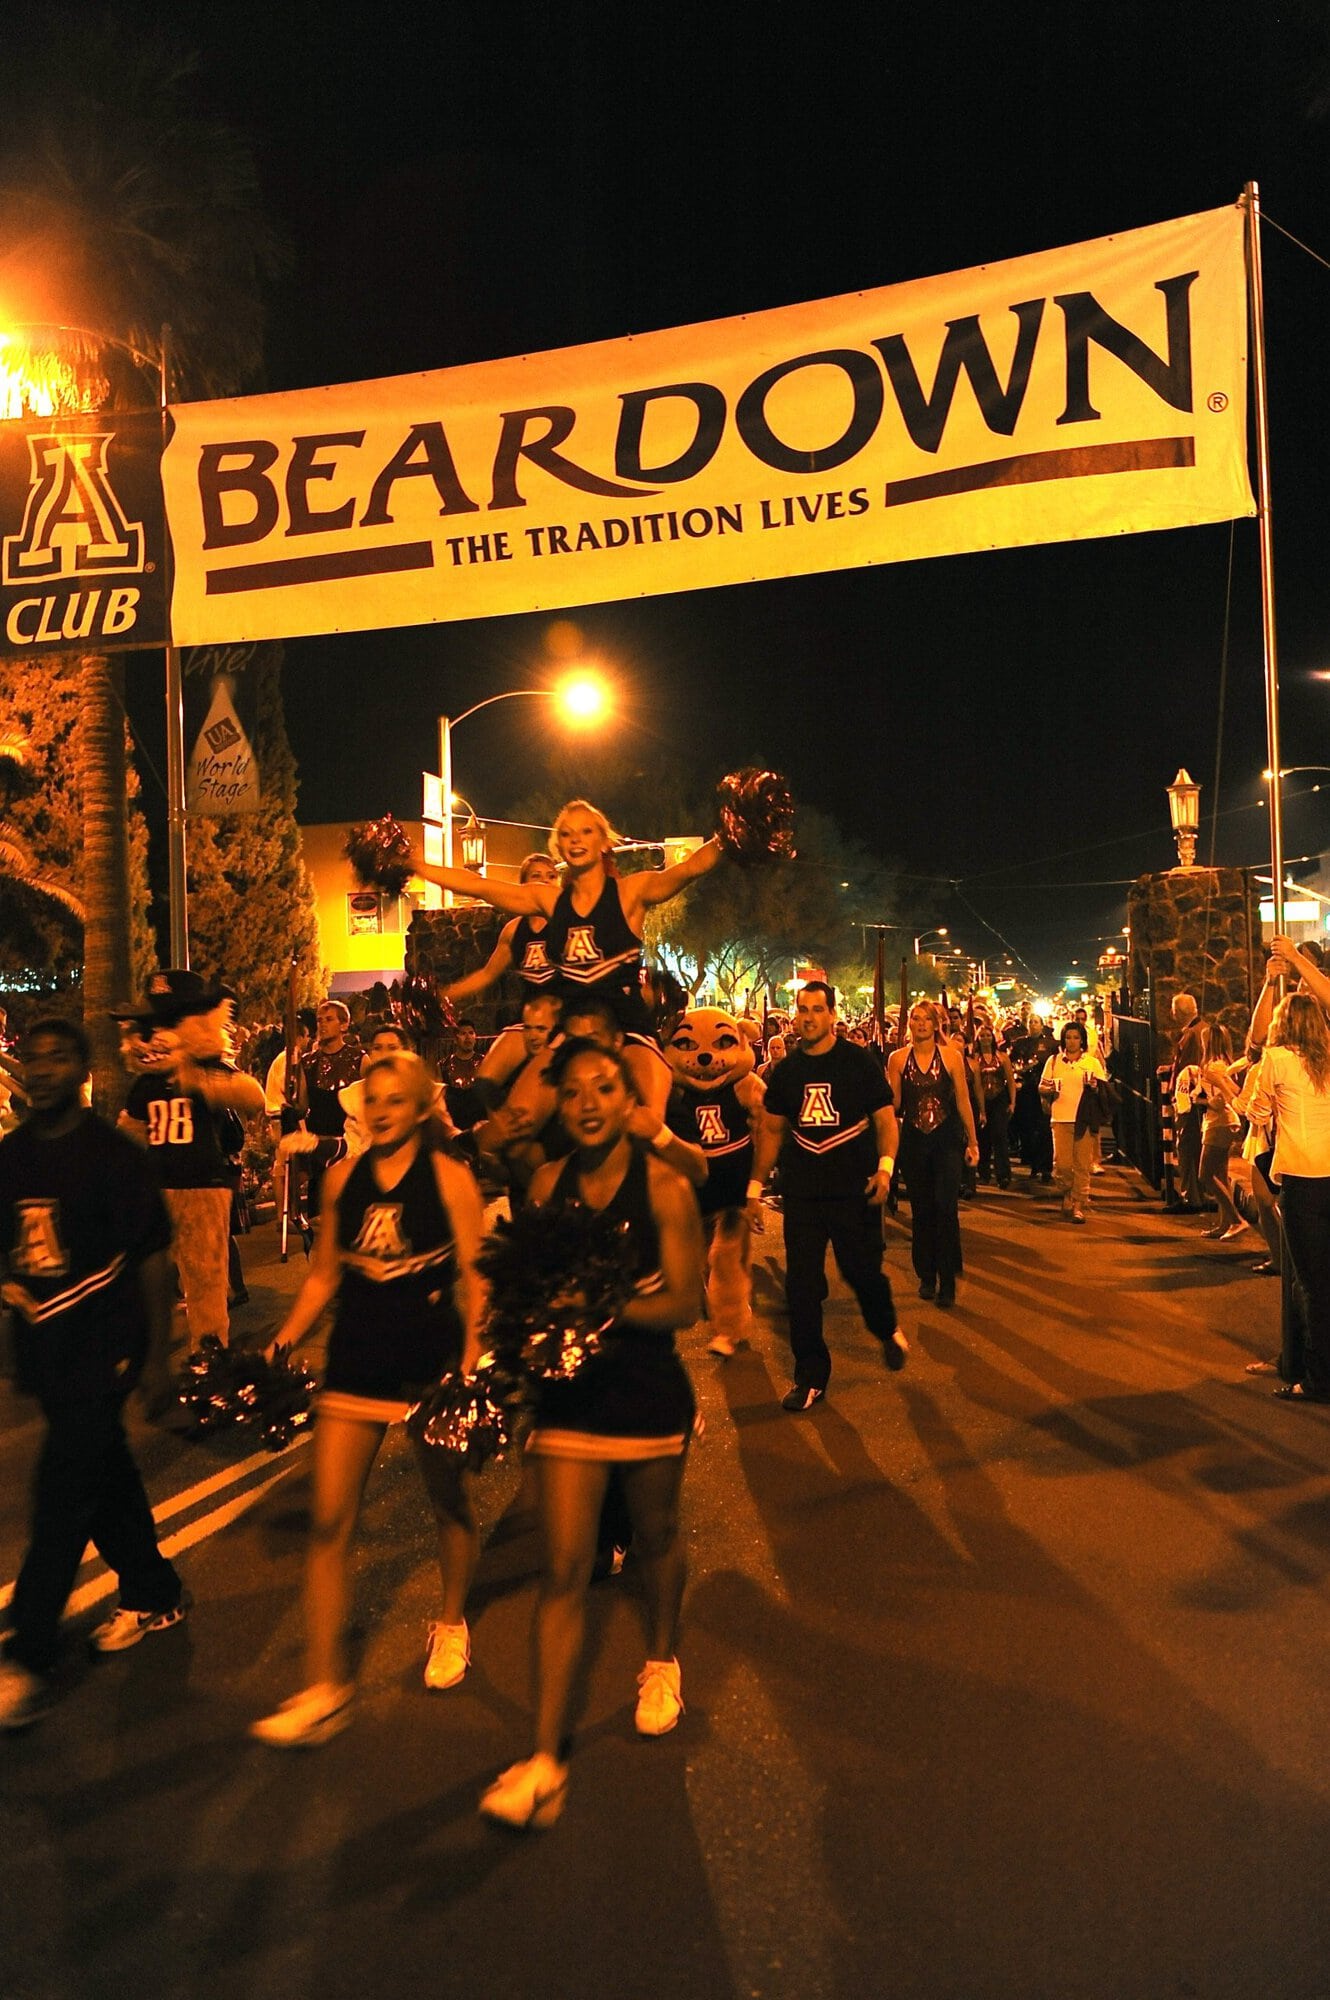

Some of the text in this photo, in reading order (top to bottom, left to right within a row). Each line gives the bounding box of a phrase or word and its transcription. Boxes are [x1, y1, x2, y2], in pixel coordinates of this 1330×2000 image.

[446, 487, 870, 566] THE TRADITION LIVES
[6, 587, 141, 645] CLUB
[196, 754, 250, 777] World
[197, 778, 251, 804] Stage
[521, 940, 550, 971] A
[562, 926, 605, 965] A
[695, 1104, 731, 1144] A
[799, 1083, 840, 1127] A
